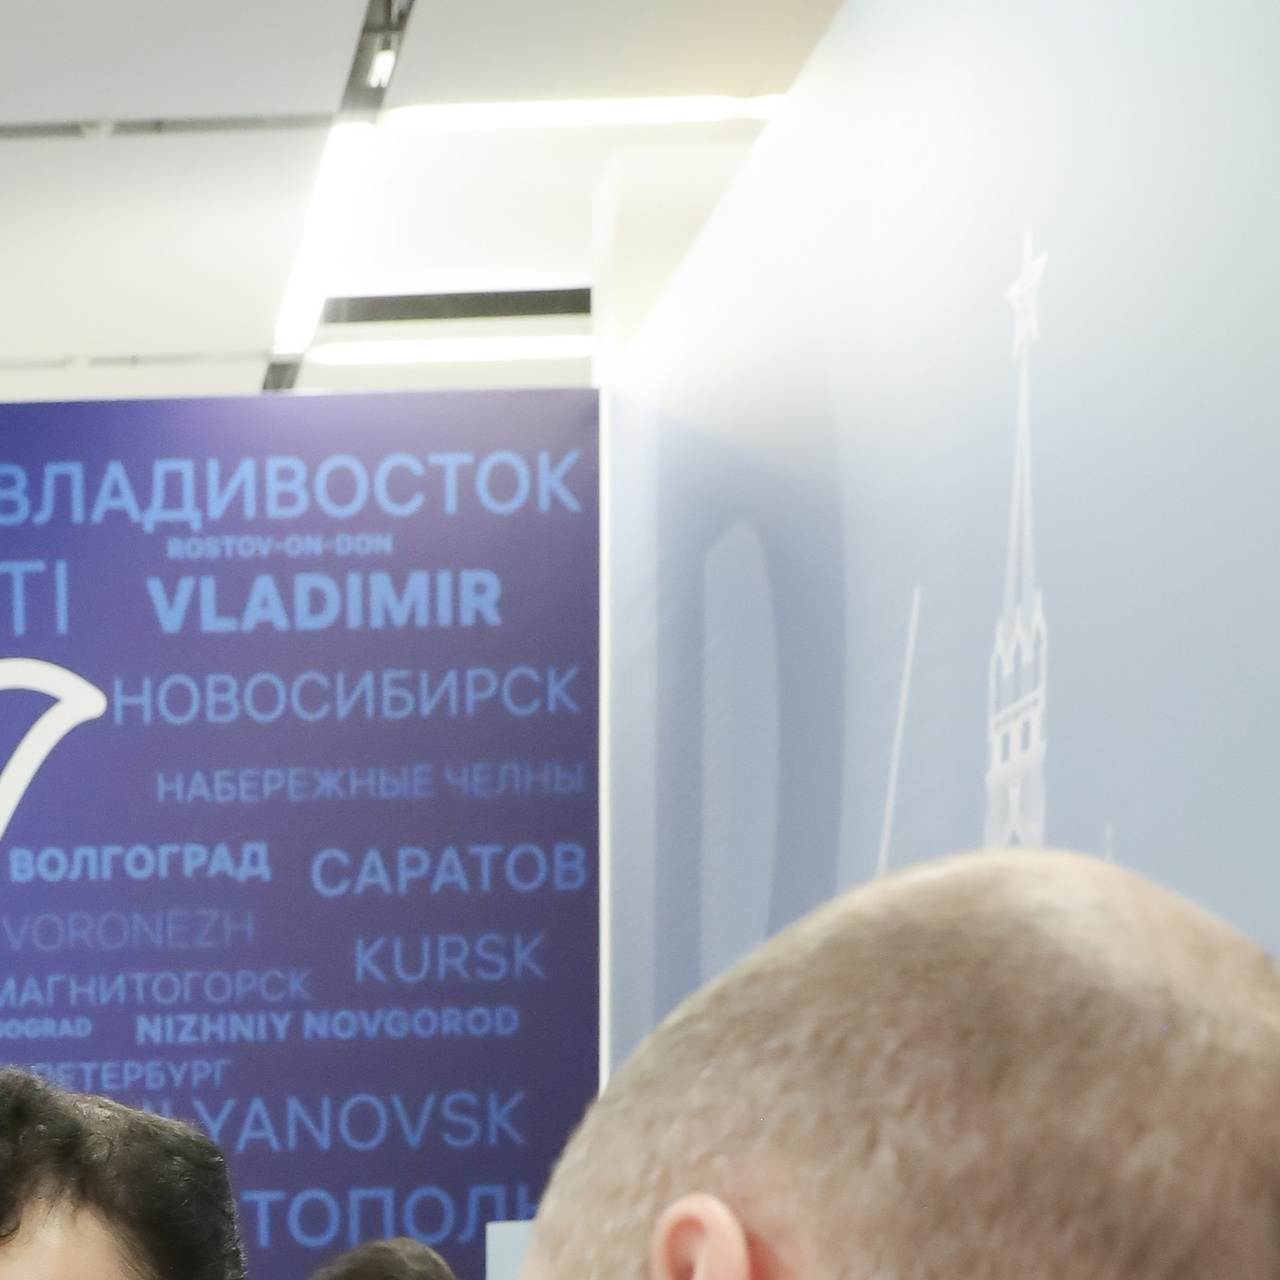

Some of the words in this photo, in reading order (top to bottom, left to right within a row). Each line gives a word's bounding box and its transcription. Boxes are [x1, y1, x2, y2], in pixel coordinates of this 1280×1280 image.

[166, 532, 394, 560] ROSTOV-ON-DON
[146, 568, 503, 634] VLADIMIR
[112, 663, 581, 727] НОВОСИБИРСК
[156, 765, 433, 804] НАБЕРЕЖНЫЕ
[444, 761, 586, 799] ЧЕЛНЫ
[9, 841, 272, 884] ВОЛГОГРАД
[310, 842, 589, 899] САРАТОВ
[0, 908, 257, 954] VORONEZH
[355, 930, 549, 985] KURSK
[135, 1010, 291, 1046] NIZHNIY
[303, 1005, 519, 1042] NOVGOROD
